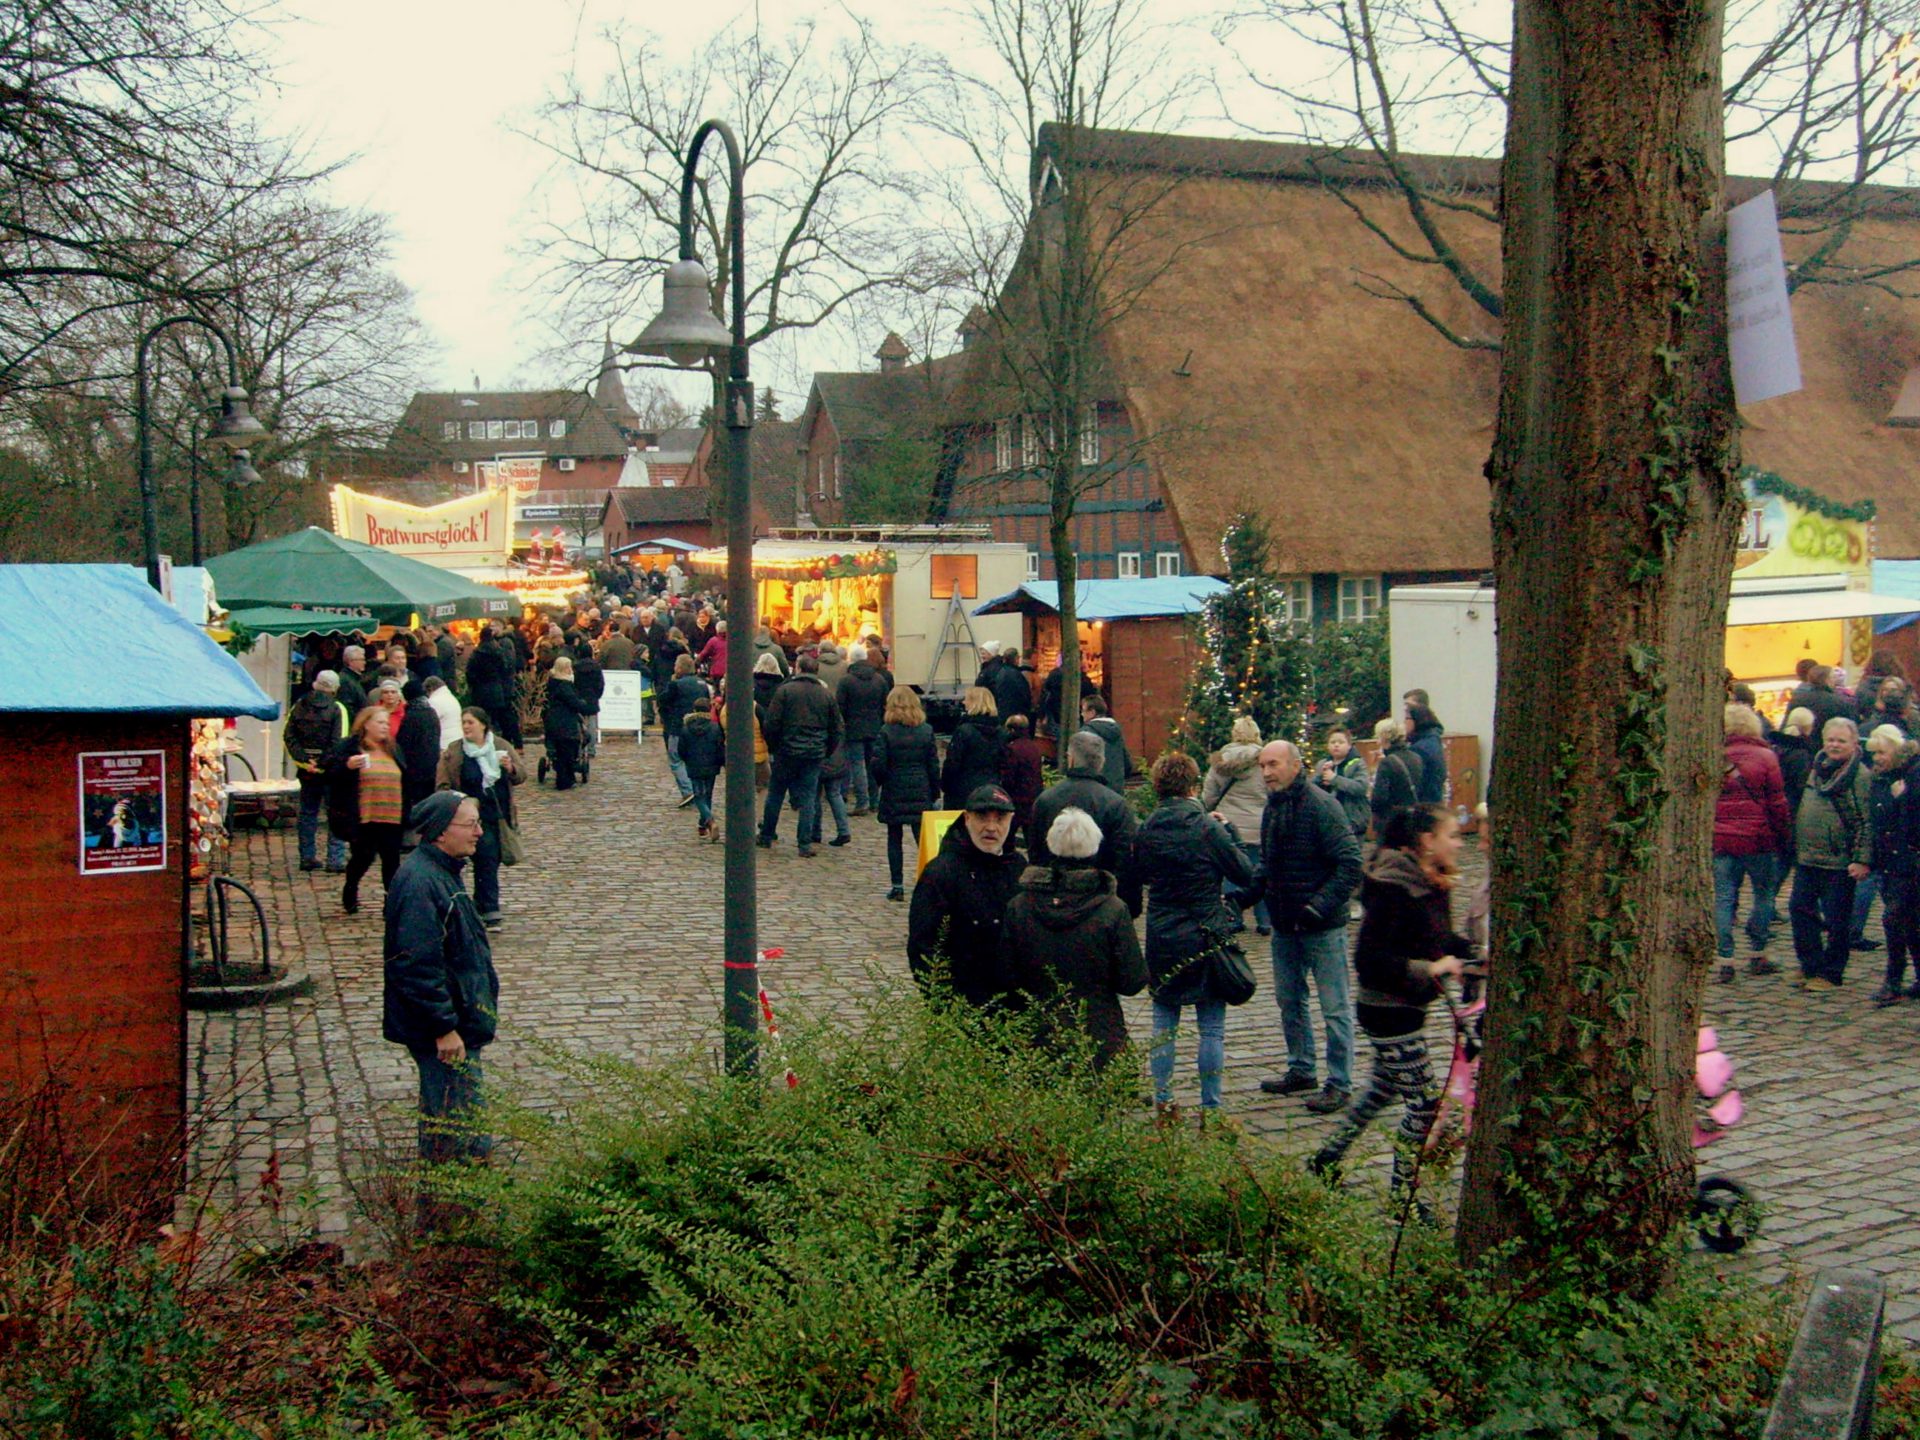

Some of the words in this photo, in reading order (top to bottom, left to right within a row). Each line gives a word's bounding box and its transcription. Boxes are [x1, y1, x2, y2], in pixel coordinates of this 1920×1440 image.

[366, 509, 489, 550] Bratwurstglöck'l
[435, 602, 457, 617] BECK'S
[489, 600, 509, 612] BECK'S
